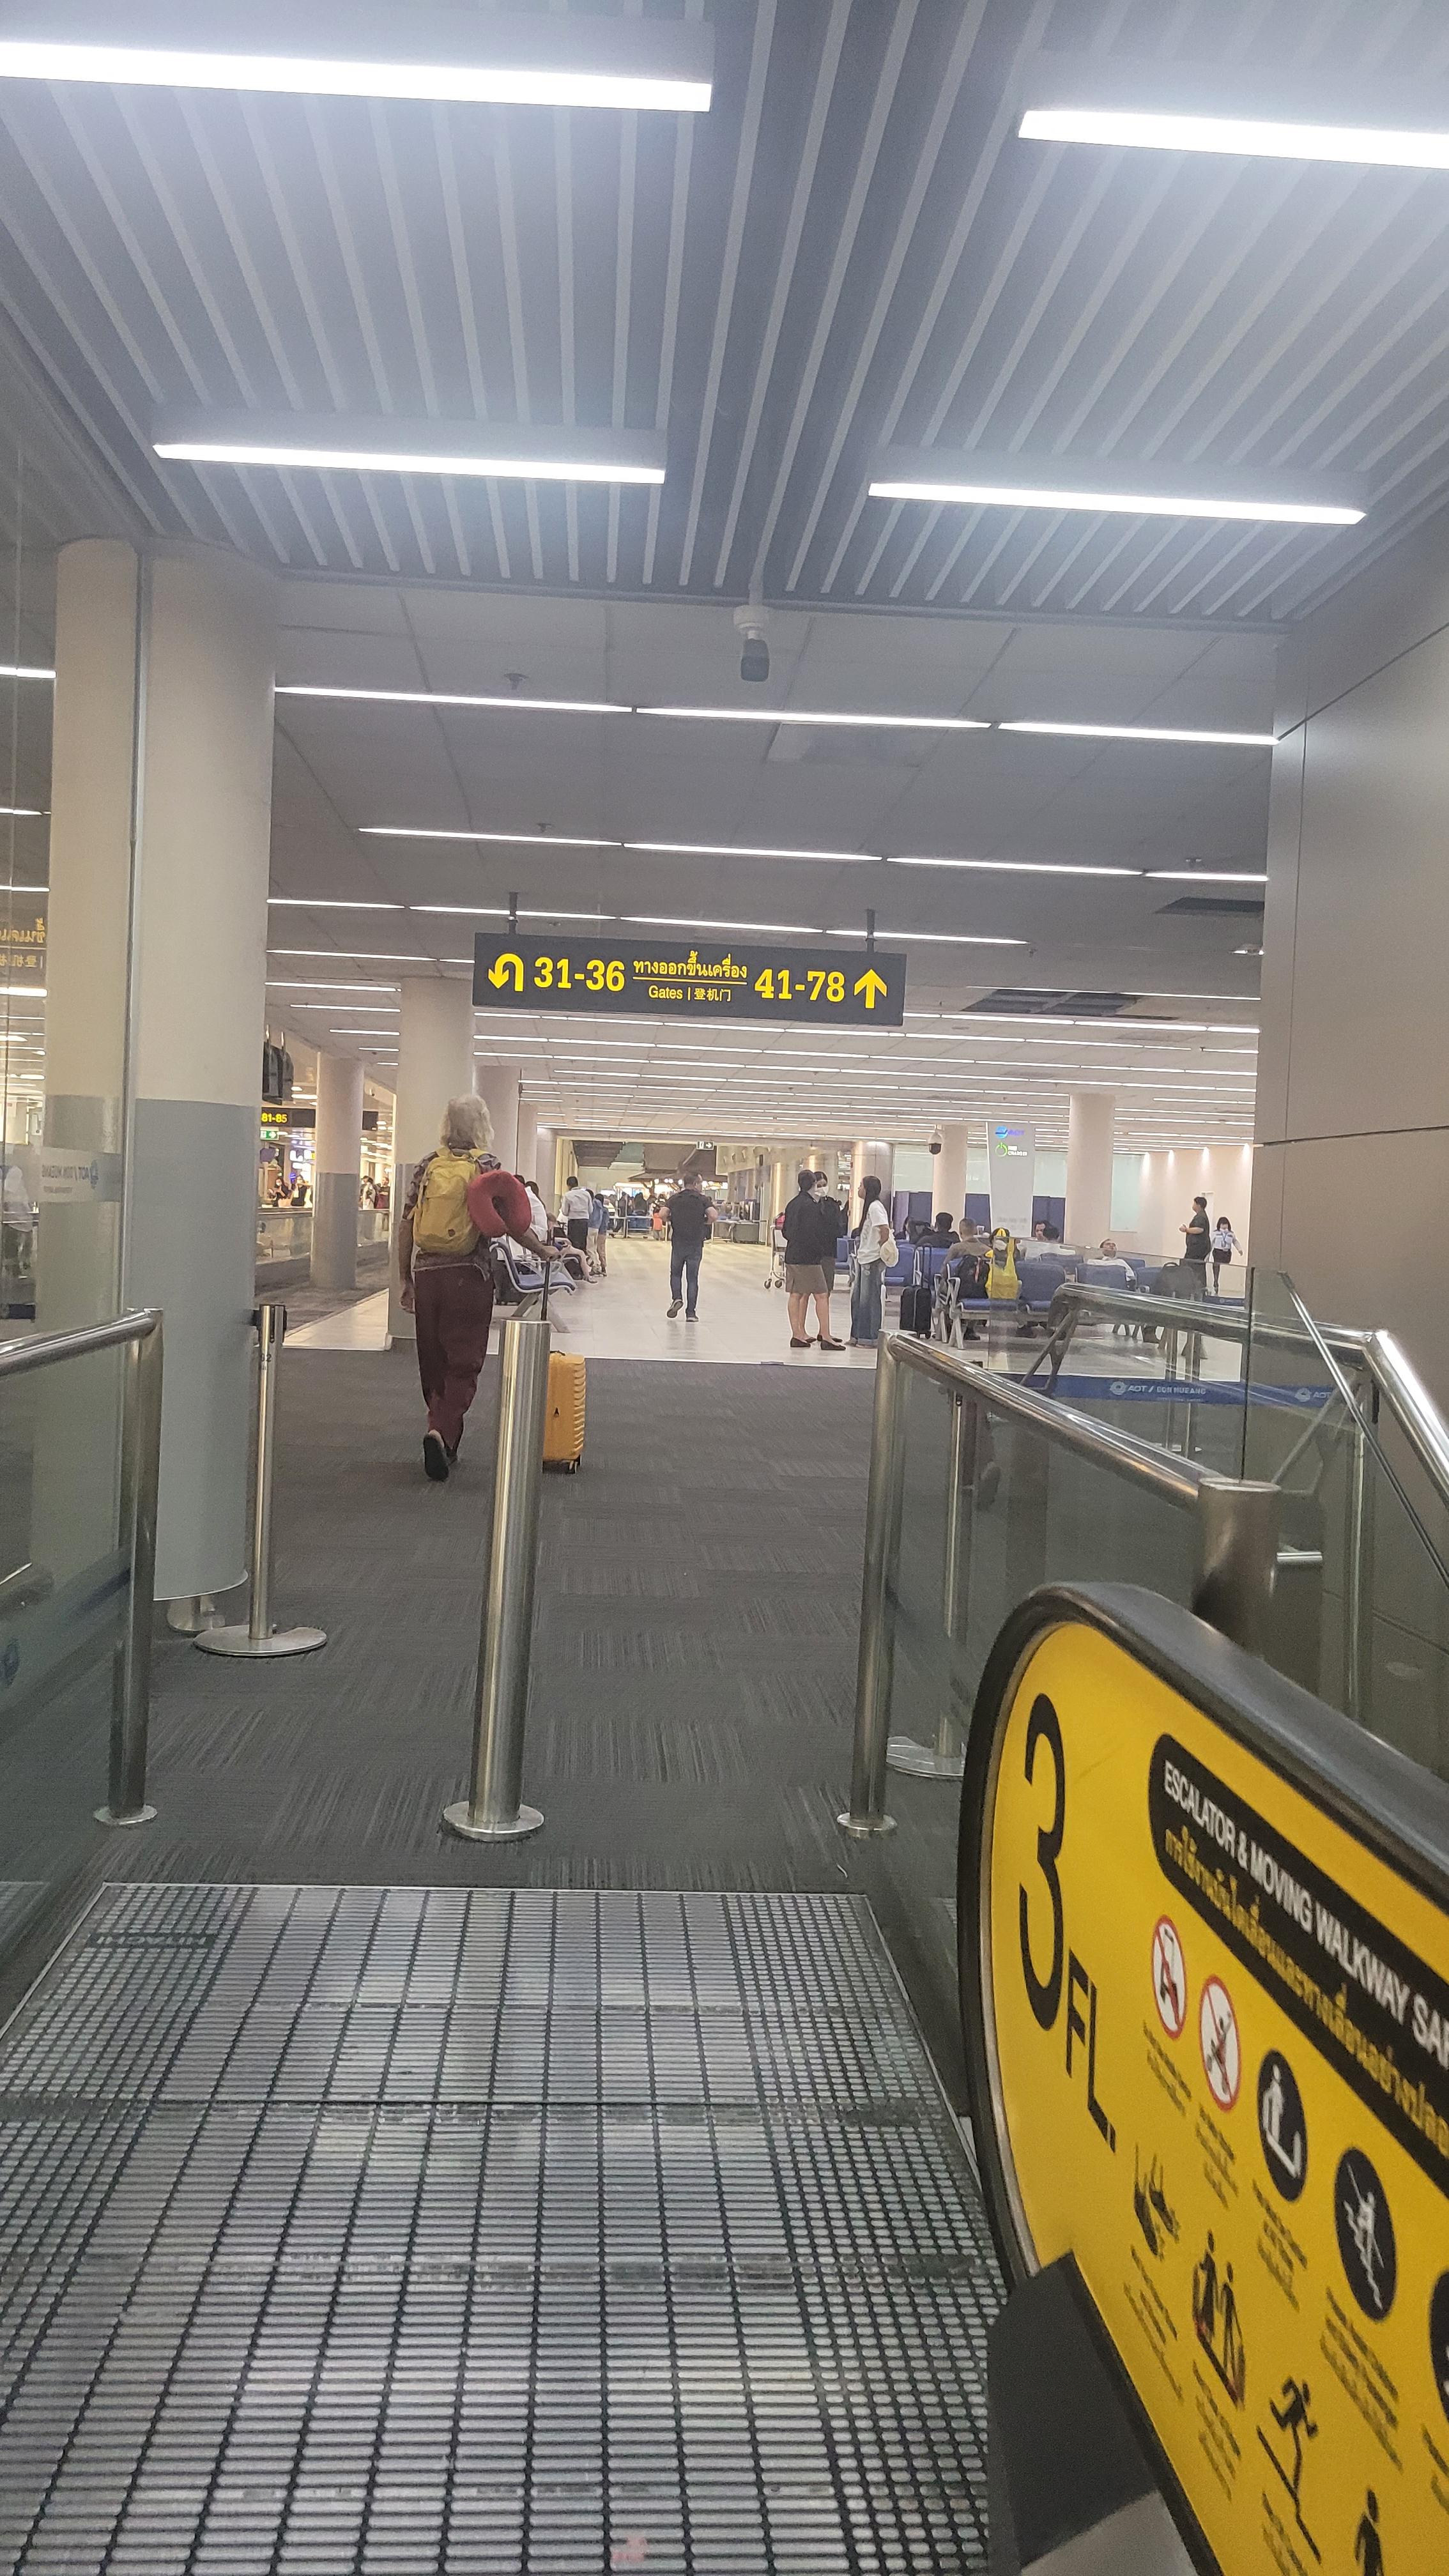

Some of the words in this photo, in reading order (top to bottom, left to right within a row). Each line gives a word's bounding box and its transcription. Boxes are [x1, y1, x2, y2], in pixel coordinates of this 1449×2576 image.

[533, 956, 625, 992] 31-36
[632, 950, 747, 979] ทางออกขึ้นเครื่อง
[648, 985, 683, 1000] Gates
[694, 987, 732, 1002] 登机门
[755, 969, 845, 1002] 41-78
[261, 1112, 288, 1123] 81-85
[1019, 1692, 1066, 2030] 3
[1165, 1759, 1236, 1859] ESCALATOR
[1250, 1840, 1313, 1935] MOVING
[1315, 1900, 1411, 2026] WALKWAY
